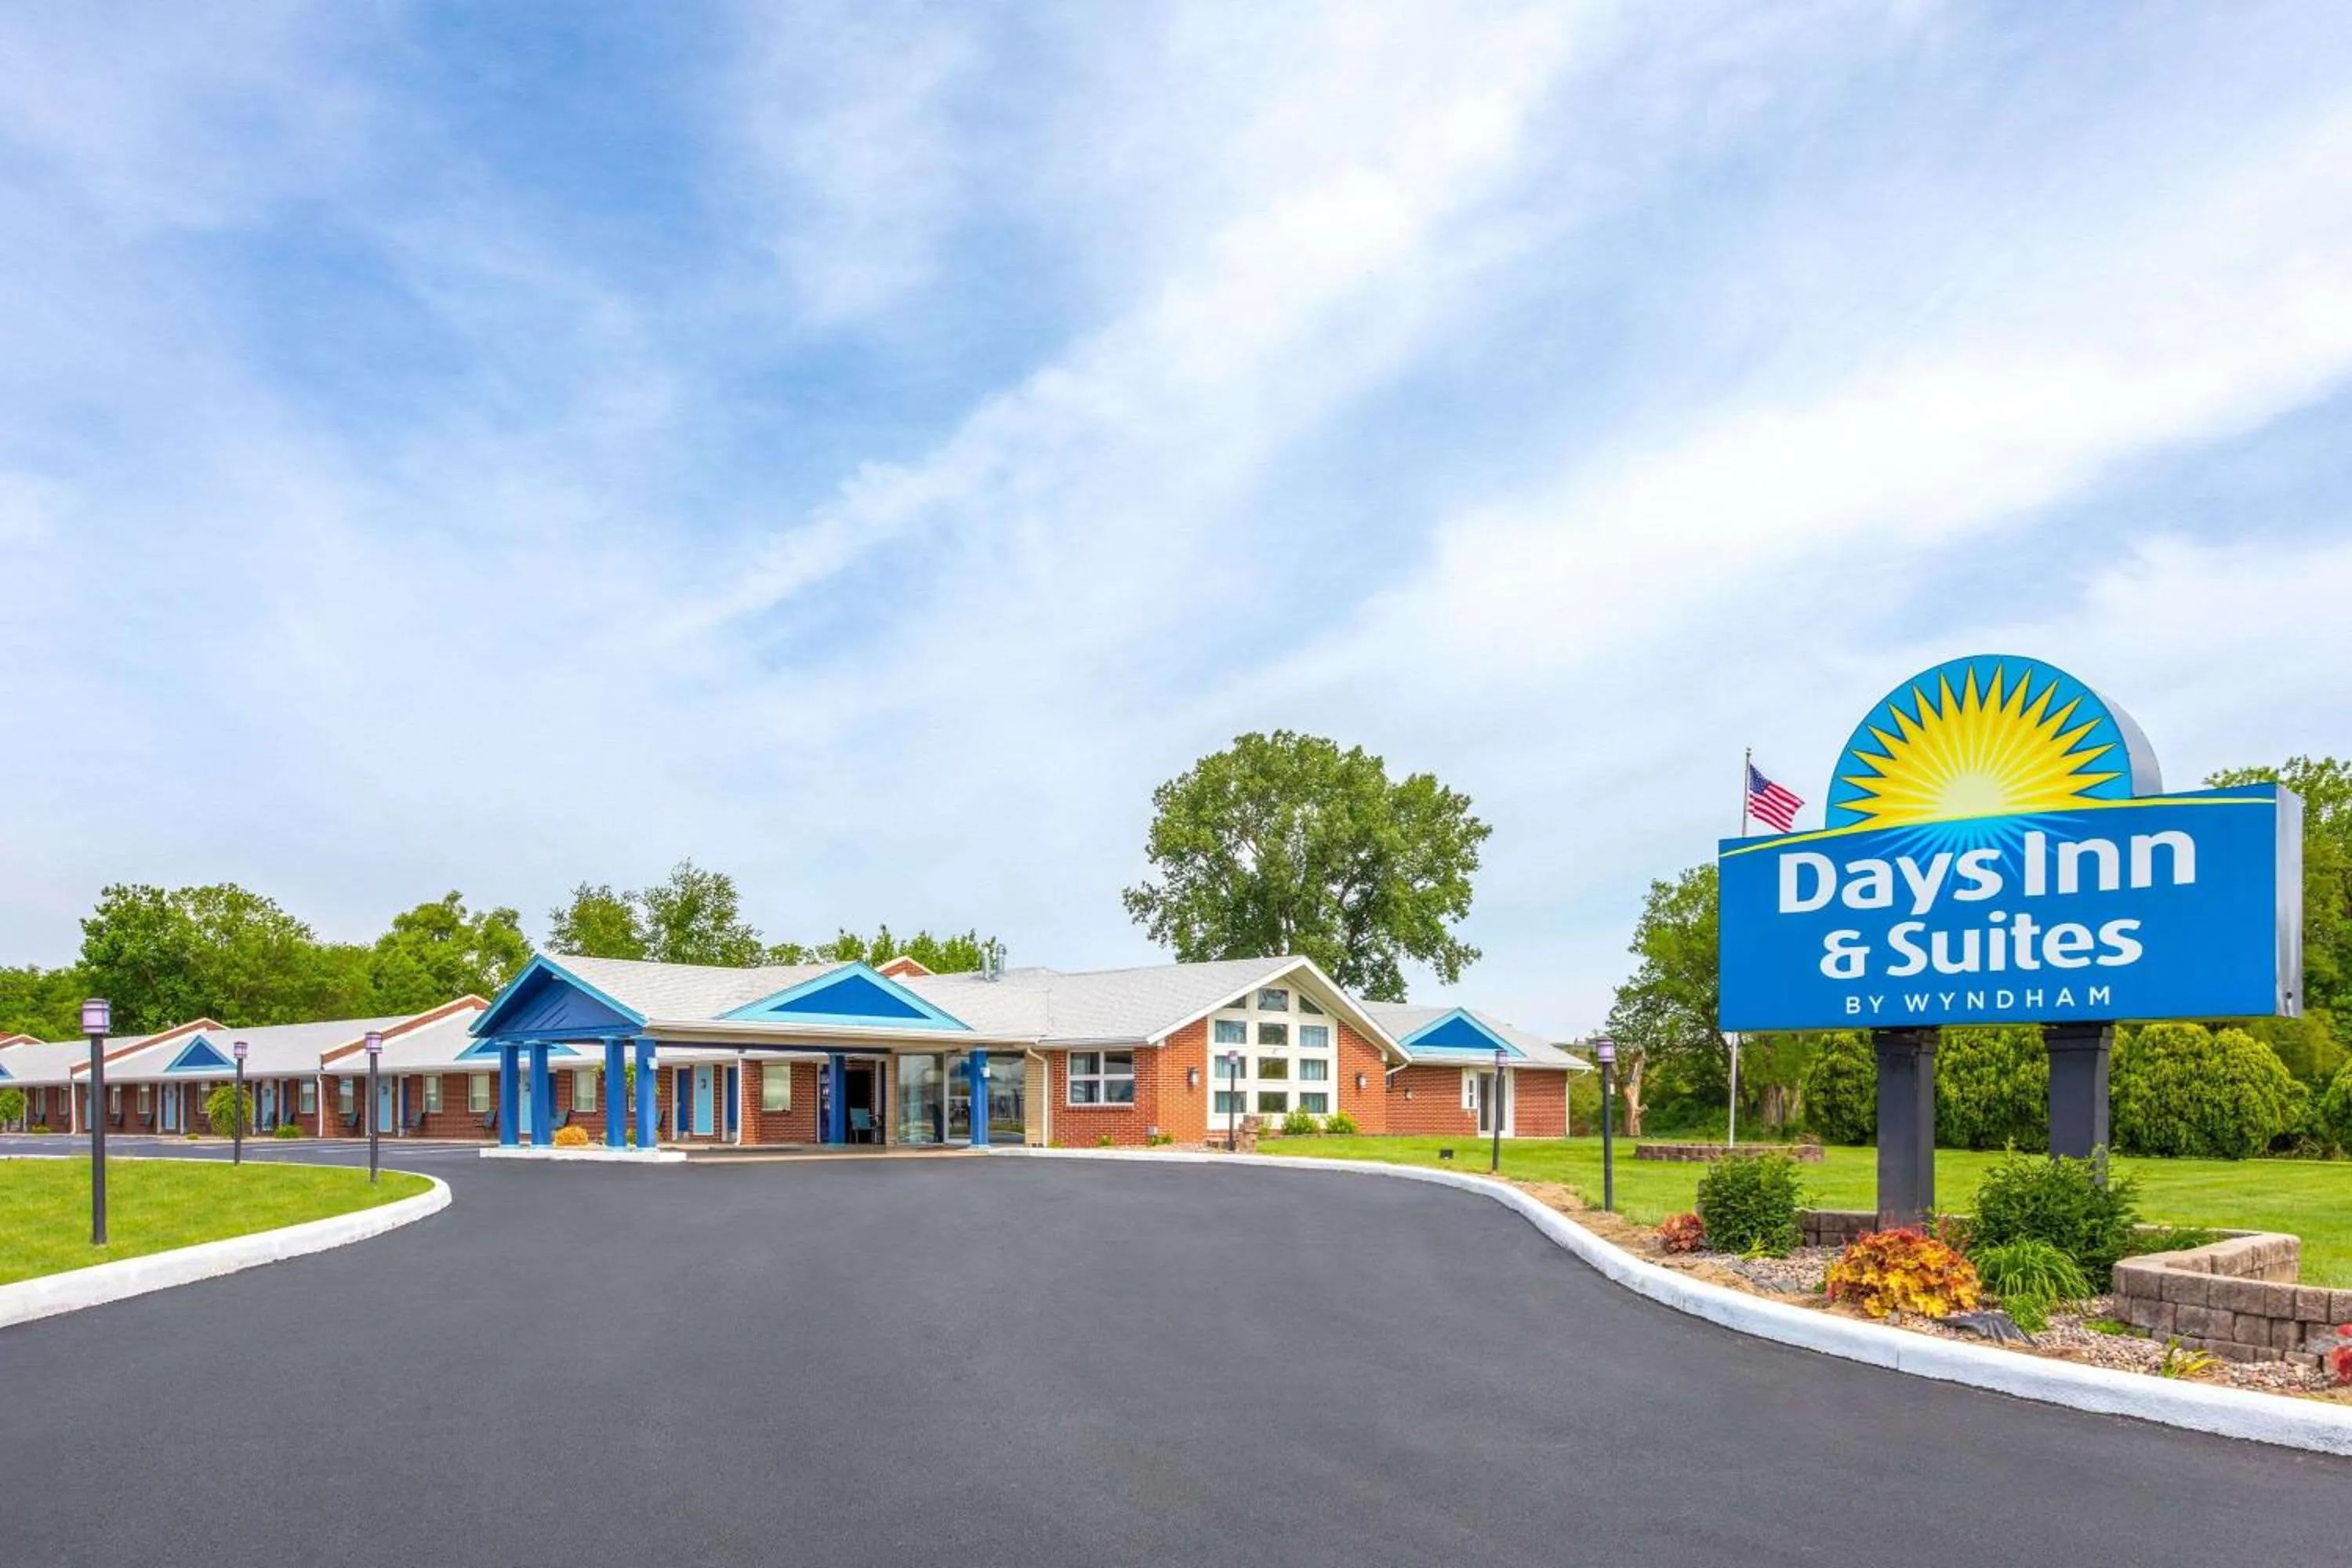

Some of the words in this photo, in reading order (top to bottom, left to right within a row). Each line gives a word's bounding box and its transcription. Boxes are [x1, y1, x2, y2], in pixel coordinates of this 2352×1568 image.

[1779, 848, 2003, 915] Days
[2024, 830, 2196, 897] Inn
[1820, 929, 1871, 980] &
[1886, 910, 2143, 977] Suites
[1846, 996, 1885, 1014] BY
[1904, 985, 2111, 1013] WYNDHAM
